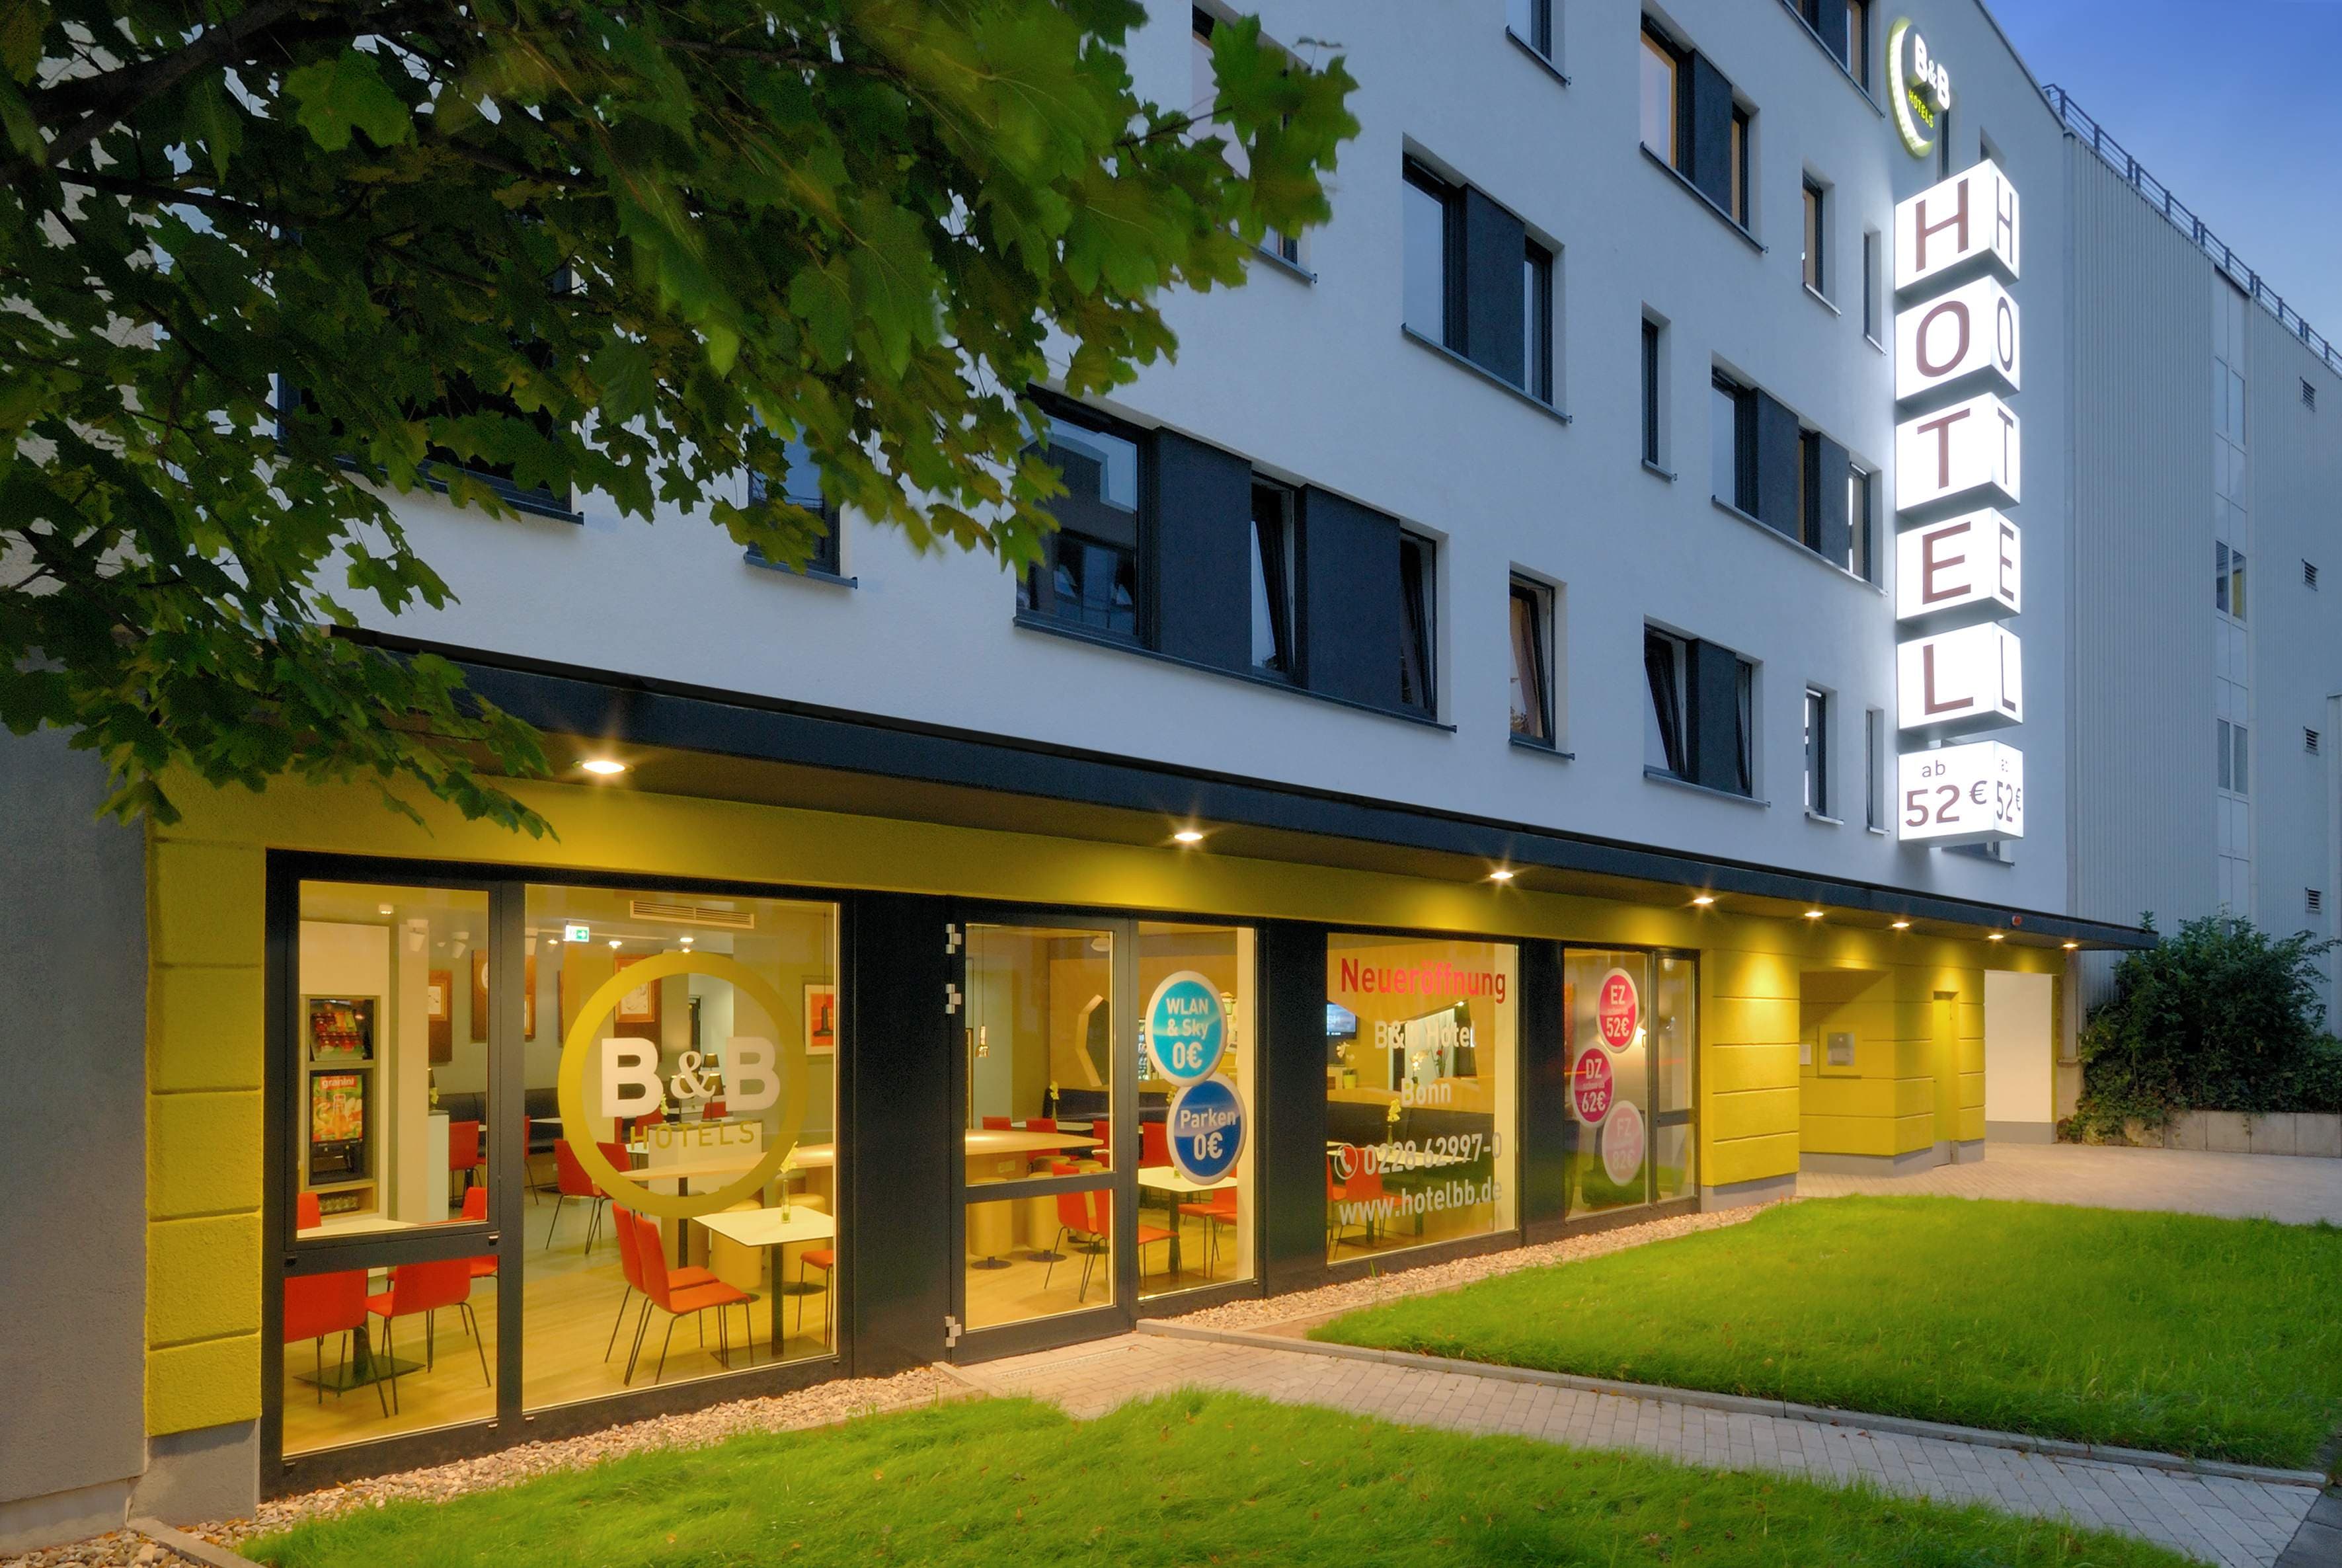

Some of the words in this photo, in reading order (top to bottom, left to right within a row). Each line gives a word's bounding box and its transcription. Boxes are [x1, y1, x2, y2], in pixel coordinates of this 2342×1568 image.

[1915, 33, 1950, 110] B&B
[1908, 89, 1934, 128] HOTELS
[1916, 177, 1974, 715] HOTEL
[1996, 175, 2016, 713] HOTEL
[1922, 760, 1946, 778] ab
[1340, 957, 1506, 1004] Neueröffnung
[1610, 984, 1625, 1005] EZ
[1166, 998, 1208, 1015] WLAN
[1167, 1019, 1179, 1037] &
[1182, 1019, 1208, 1040] Sky
[1426, 1020, 1477, 1048] Hotel
[1606, 1017, 1629, 1037] 52€
[1173, 1042, 1202, 1070] 0€
[1586, 1058, 1602, 1079] DZ
[321, 1077, 355, 1089] granini
[602, 1037, 780, 1118] B&B
[1401, 1077, 1452, 1108] Bonn
[1581, 1090, 1606, 1113] 62€
[1180, 1109, 1237, 1128] Parken
[630, 1120, 755, 1151] HOTELS
[1194, 1132, 1223, 1161] 0€
[1364, 1140, 1417, 1176] 0228
[1423, 1131, 1503, 1167] 62997-0
[1339, 1175, 1503, 1226] www.hotelbb.de
